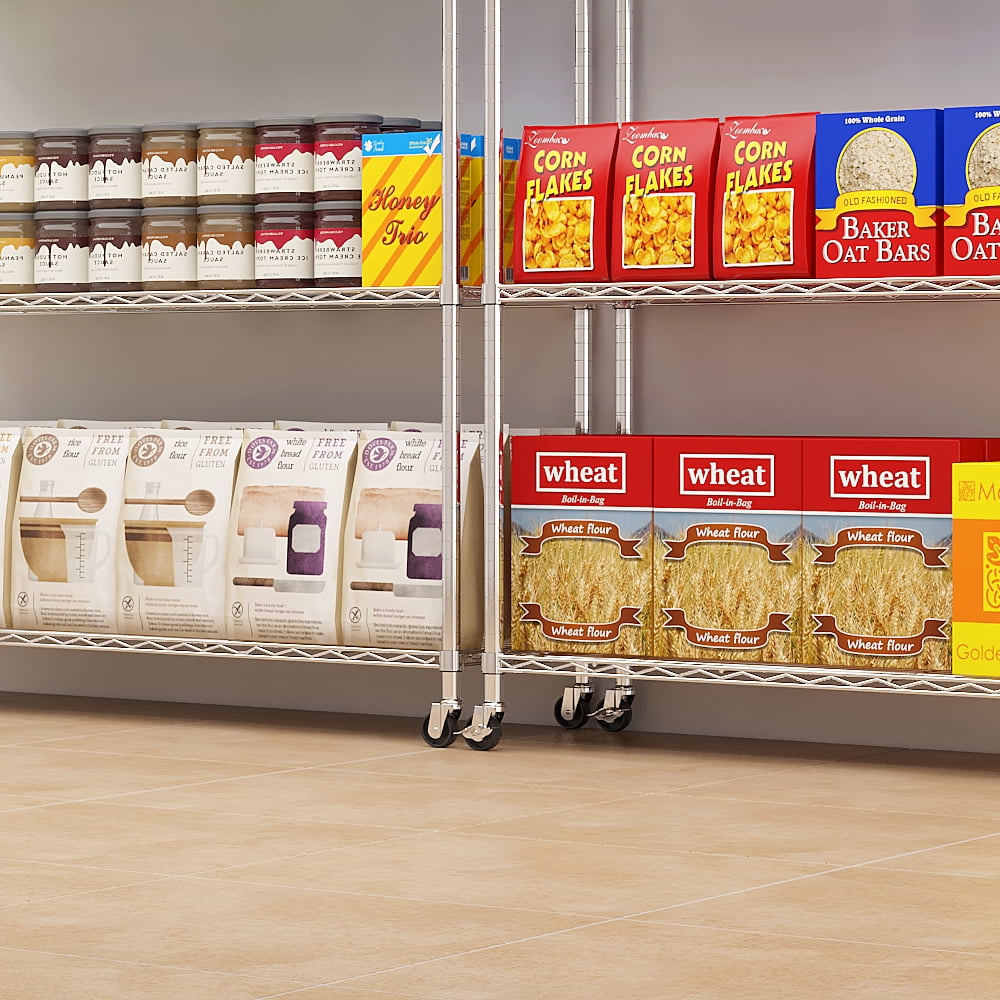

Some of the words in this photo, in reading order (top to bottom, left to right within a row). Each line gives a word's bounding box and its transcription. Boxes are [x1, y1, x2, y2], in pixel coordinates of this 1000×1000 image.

[844, 117, 861, 125] 100%
[862, 116, 884, 124] Whole
[885, 115, 906, 123] Grain
[974, 111, 992, 119] 100%
[631, 144, 687, 169] CORN
[733, 140, 787, 165] CORN
[533, 150, 587, 174] CORN
[625, 164, 693, 203] FLAKES
[725, 159, 793, 200] FLAKES
[526, 168, 593, 208] FLAKES
[368, 185, 441, 221] Honey
[843, 197, 860, 206] OLD
[861, 196, 907, 205] FASHIONED
[973, 193, 990, 202] OLD
[382, 220, 428, 246] Trio
[841, 216, 911, 240] BAKER
[822, 239, 870, 264] OAT
[875, 238, 931, 263] BARS
[67, 438, 82, 447] rice
[96, 434, 124, 444] FREE
[286, 437, 307, 446] white
[316, 438, 347, 448] FREE
[404, 439, 427, 448] white
[62, 450, 80, 459] flour
[91, 446, 120, 455] FROM
[280, 450, 302, 458] bread
[312, 451, 343, 460] FROM
[399, 451, 422, 460] bread
[88, 459, 118, 467] GLUTEN
[277, 461, 295, 470] flour
[309, 463, 340, 471] GLUTEN
[396, 463, 414, 472] flour
[543, 460, 619, 483] wheat
[688, 462, 767, 487] wheat
[838, 464, 921, 488] wheat
[561, 495, 605, 505] Boil-in-Bag
[706, 498, 753, 509] Boil-in-Bag
[858, 501, 907, 512] Boil-in-Bag
[550, 523, 584, 534] Wheat
[586, 524, 612, 535] flour
[695, 527, 731, 539] Wheat
[733, 528, 760, 539] flour
[847, 530, 885, 542] Wheat
[887, 531, 915, 543] flour
[550, 626, 584, 637] Wheat
[586, 626, 612, 638] flour
[695, 632, 731, 644] Wheat
[733, 633, 760, 645] flour
[847, 639, 884, 650] Wheat
[887, 640, 914, 652] flour
